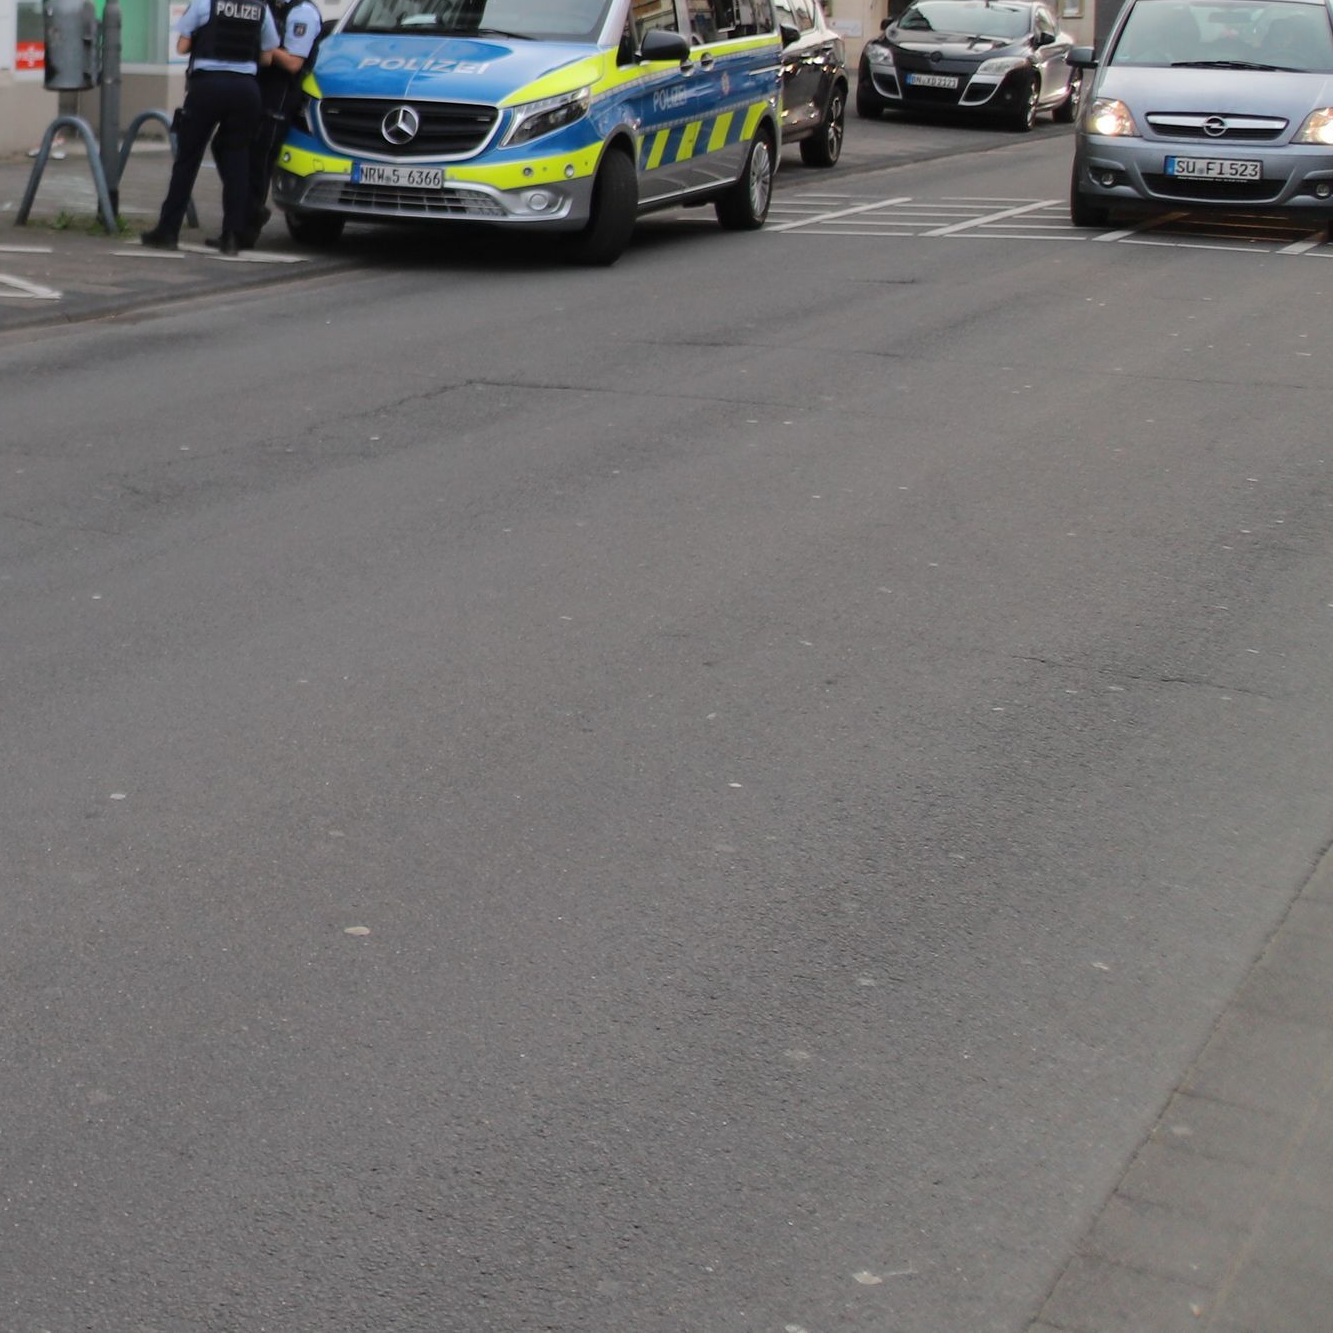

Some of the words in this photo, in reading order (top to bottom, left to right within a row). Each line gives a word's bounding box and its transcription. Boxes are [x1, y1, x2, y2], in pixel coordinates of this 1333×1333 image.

[216, 1, 262, 22] POLIZEI
[357, 57, 491, 75] POLIZEI
[653, 85, 687, 113] POLIZEI
[361, 168, 384, 183] NRW
[1176, 160, 1196, 174] SU
[1229, 163, 1258, 177] 523
